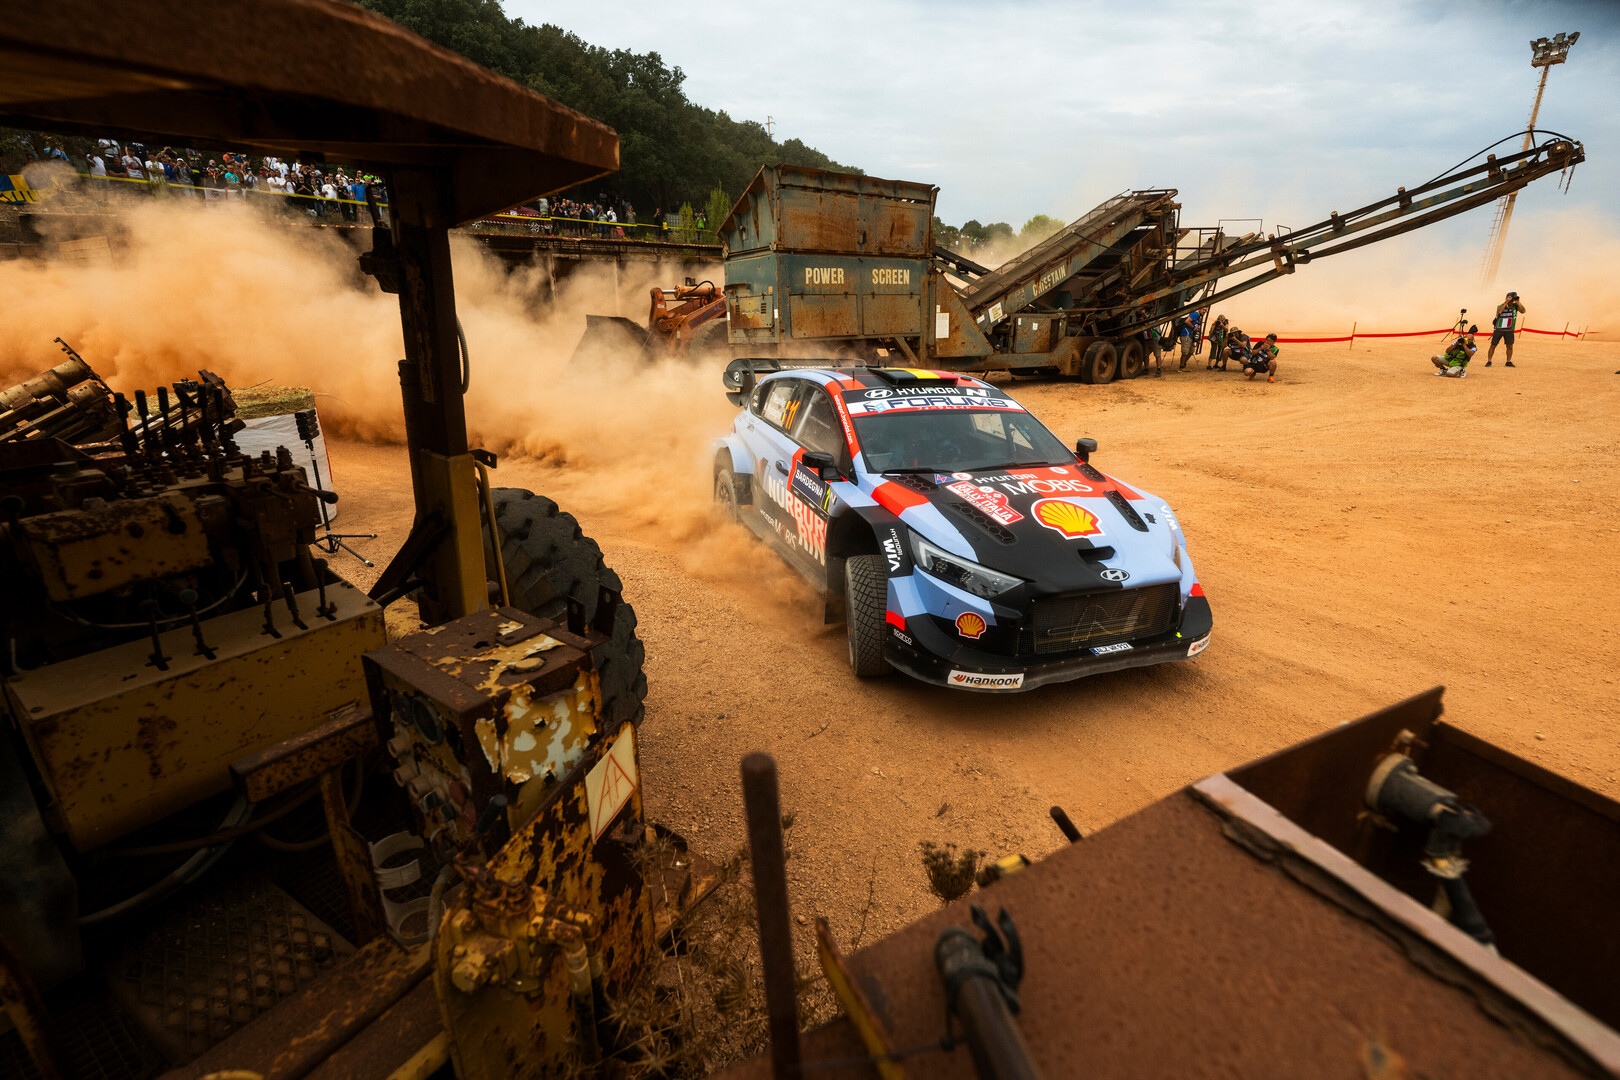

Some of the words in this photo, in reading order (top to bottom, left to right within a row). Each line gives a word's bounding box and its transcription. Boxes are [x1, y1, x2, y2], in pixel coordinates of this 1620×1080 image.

[805, 267, 845, 285] POWER
[872, 268, 910, 285] SCREEN
[687, 301, 726, 328] W230
[896, 387, 960, 395] HYUNDAI
[887, 397, 1009, 409] FORUM8
[785, 400, 800, 430] 11
[795, 469, 824, 498] SARDEGNA
[975, 473, 1038, 484] HYUNDAI
[1001, 479, 1094, 496] MOBIS
[955, 484, 984, 500] RALLY
[980, 499, 1013, 521] ITALIA
[889, 528, 904, 556] HYUNDAI
